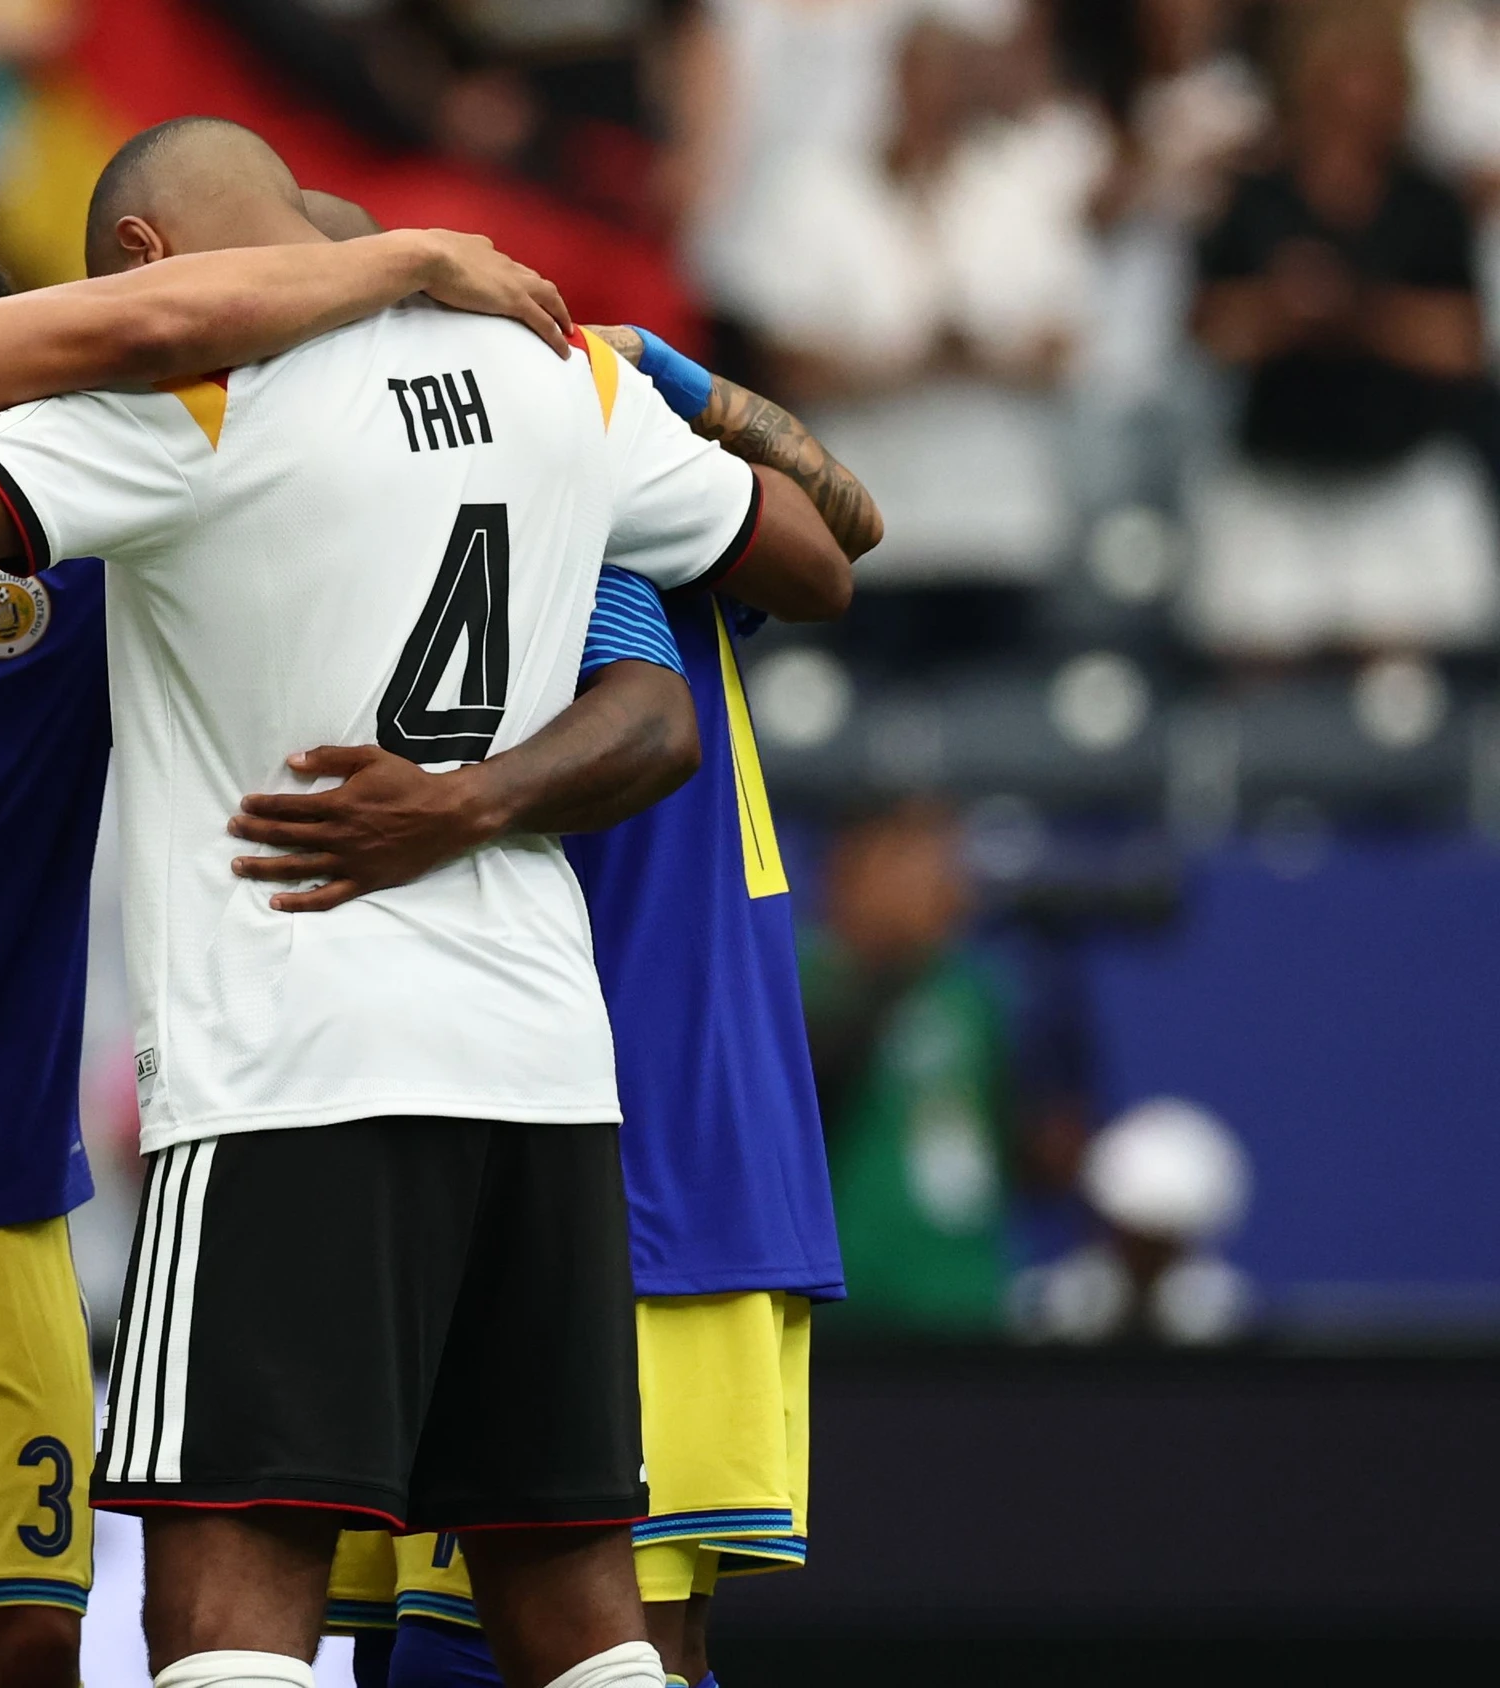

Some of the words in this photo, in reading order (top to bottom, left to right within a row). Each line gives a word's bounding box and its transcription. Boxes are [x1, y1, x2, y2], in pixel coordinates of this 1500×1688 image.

[387, 368, 493, 452] TAH
[376, 503, 510, 767] 4
[17, 1435, 73, 1558] 3
